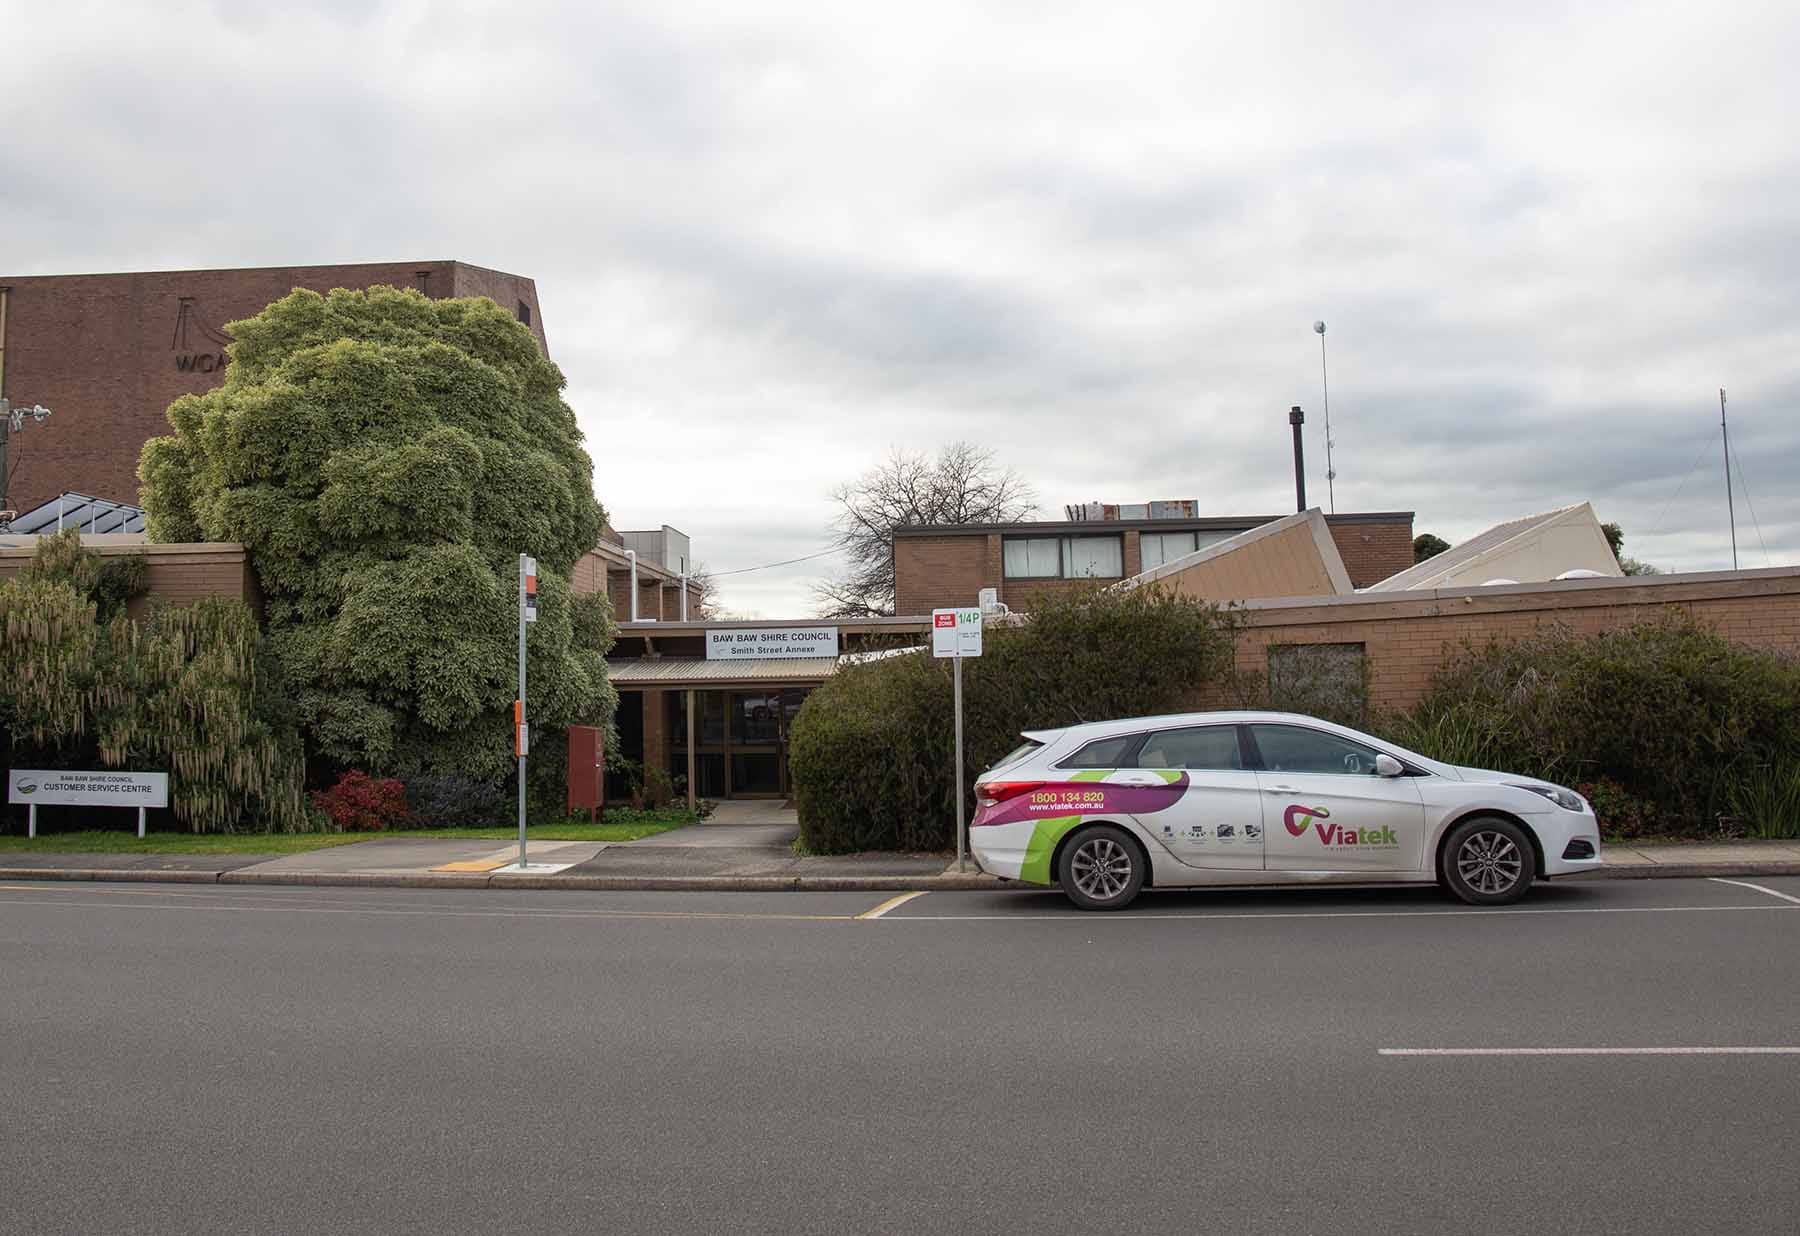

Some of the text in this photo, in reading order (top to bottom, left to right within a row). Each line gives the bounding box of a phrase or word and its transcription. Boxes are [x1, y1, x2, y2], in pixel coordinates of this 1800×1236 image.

[713, 632, 831, 643] BAW BAW SHIRE COUNCIL
[730, 647, 754, 655] Smith
[757, 646, 782, 654] Street
[89, 775, 106, 783] SHIRE
[44, 783, 152, 793] CUSTOMER SERVICE CENTRE
[1031, 792, 1104, 803] 1800 134 820
[1029, 803, 1104, 811] www.viatek.com.au
[1315, 824, 1398, 845] Viatek
